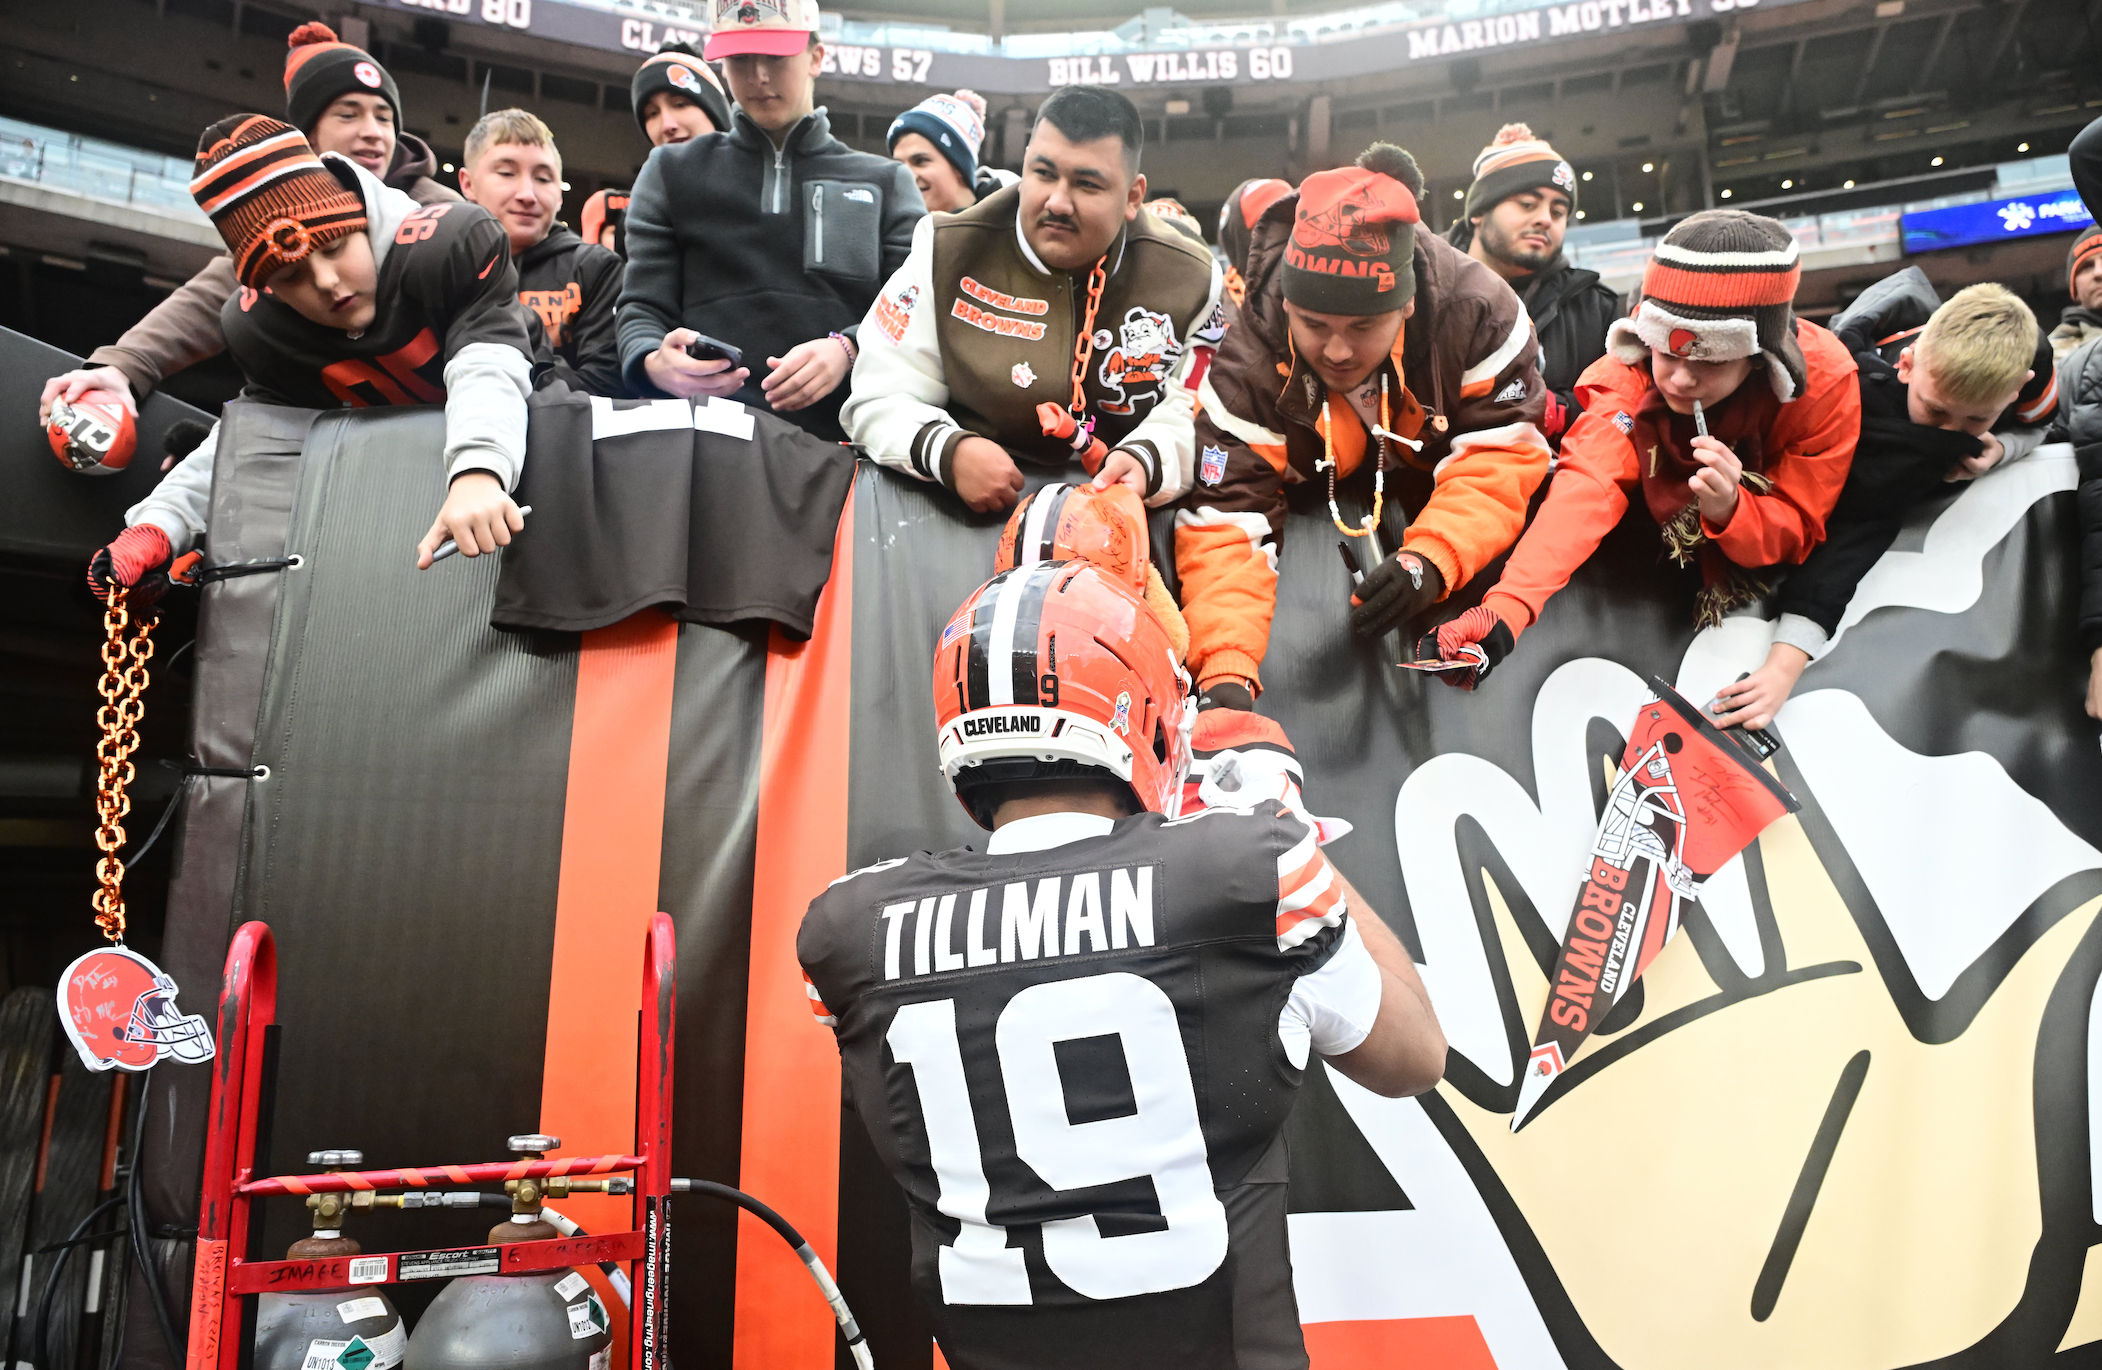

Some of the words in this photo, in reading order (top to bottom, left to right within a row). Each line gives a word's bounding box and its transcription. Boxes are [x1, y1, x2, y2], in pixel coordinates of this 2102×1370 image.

[1406, 10, 1541, 60] MARION
[892, 47, 933, 83] 57
[1048, 55, 1120, 86] BILL
[1126, 50, 1238, 83] WILLIS
[1249, 47, 1293, 80] 60
[961, 276, 1049, 315] CLEVELAND
[952, 298, 1046, 340] BROWNS
[1202, 462, 1221, 481] NFL
[963, 715, 1041, 737] CLEVELAND
[882, 865, 1155, 980] TILLMAN
[1551, 857, 1629, 1032] BROWNS
[1600, 901, 1636, 994] CLEVELAND
[885, 972, 1229, 1306] 19
[428, 1249, 470, 1260] Escort
[307, 1356, 335, 1370] UN1013
